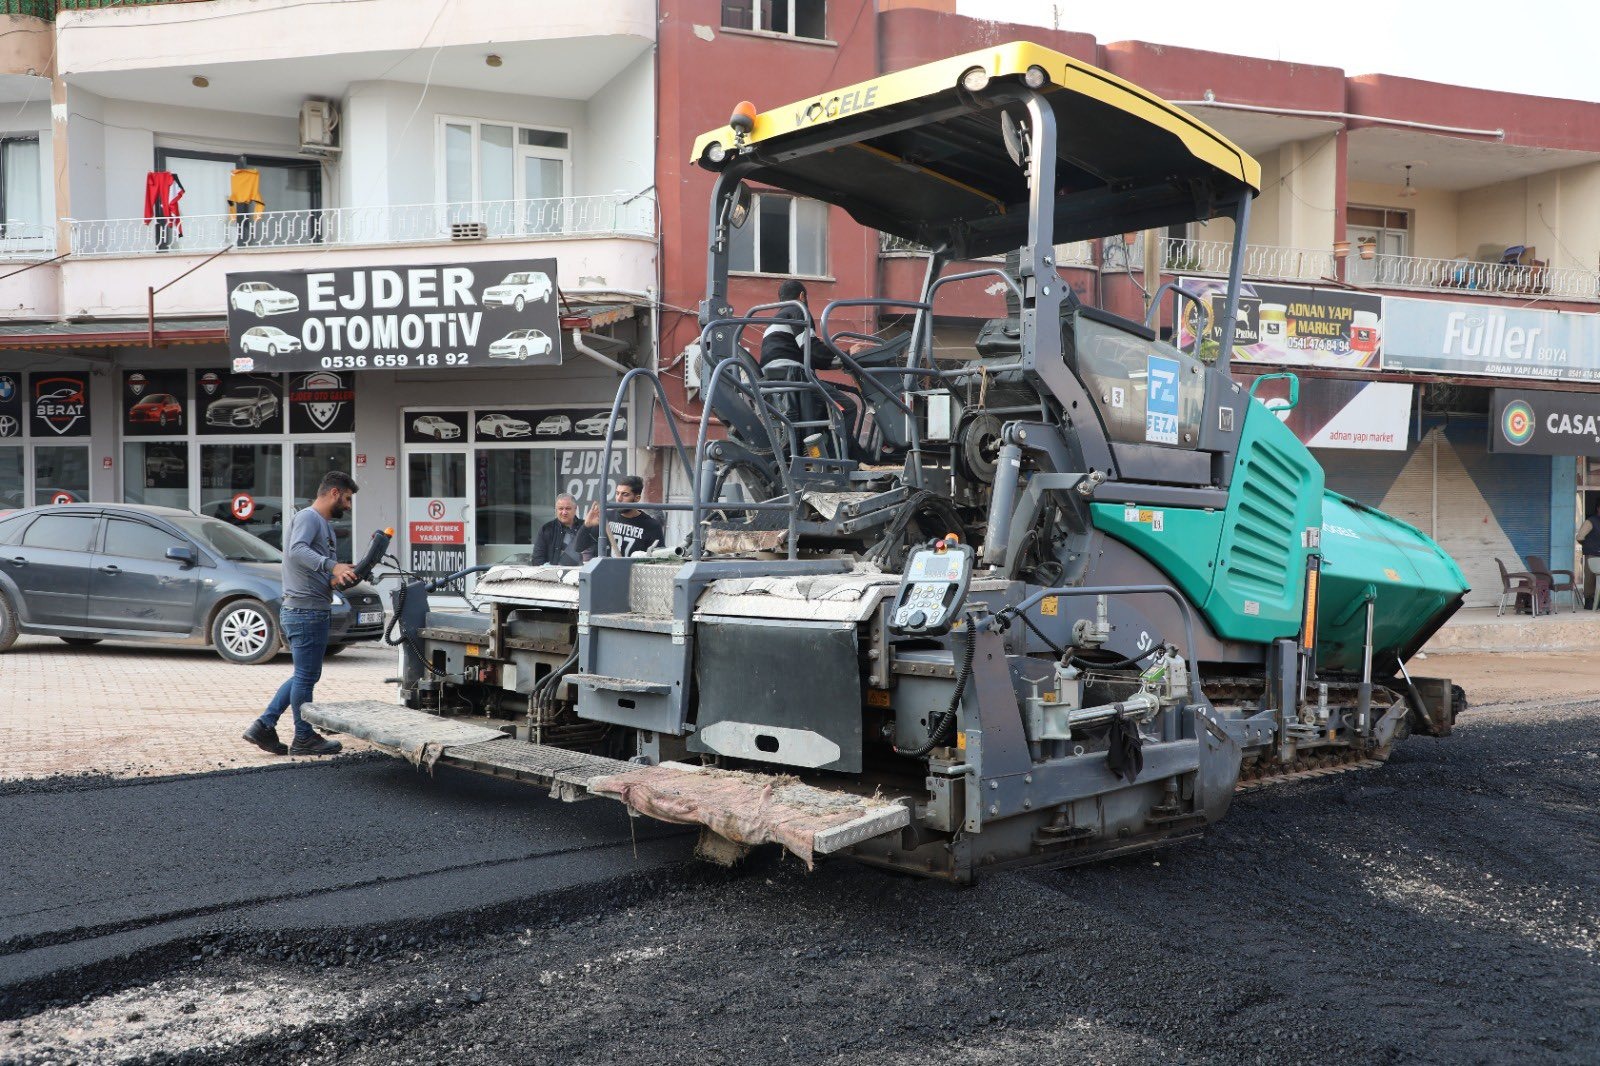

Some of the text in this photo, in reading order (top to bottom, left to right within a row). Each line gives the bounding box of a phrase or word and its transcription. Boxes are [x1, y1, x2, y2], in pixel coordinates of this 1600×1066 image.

[306, 267, 478, 312] EJDER
[1287, 303, 1353, 321] ADNAN YAPI
[1298, 320, 1341, 336] MARKET
[1288, 337, 1350, 352] 0541 474 84 94
[321, 352, 469, 368] 0536 659 18 92
[1538, 347, 1567, 362] BOYA
[1485, 364, 1512, 374] ADNAN
[1531, 367, 1563, 377] MARKET
[37, 404, 84, 416] BERAT
[1329, 430, 1352, 440] adnan
[1369, 433, 1393, 443] market
[413, 551, 465, 572] EJDER YIRTICI
[456, 577, 465, 592] 92
